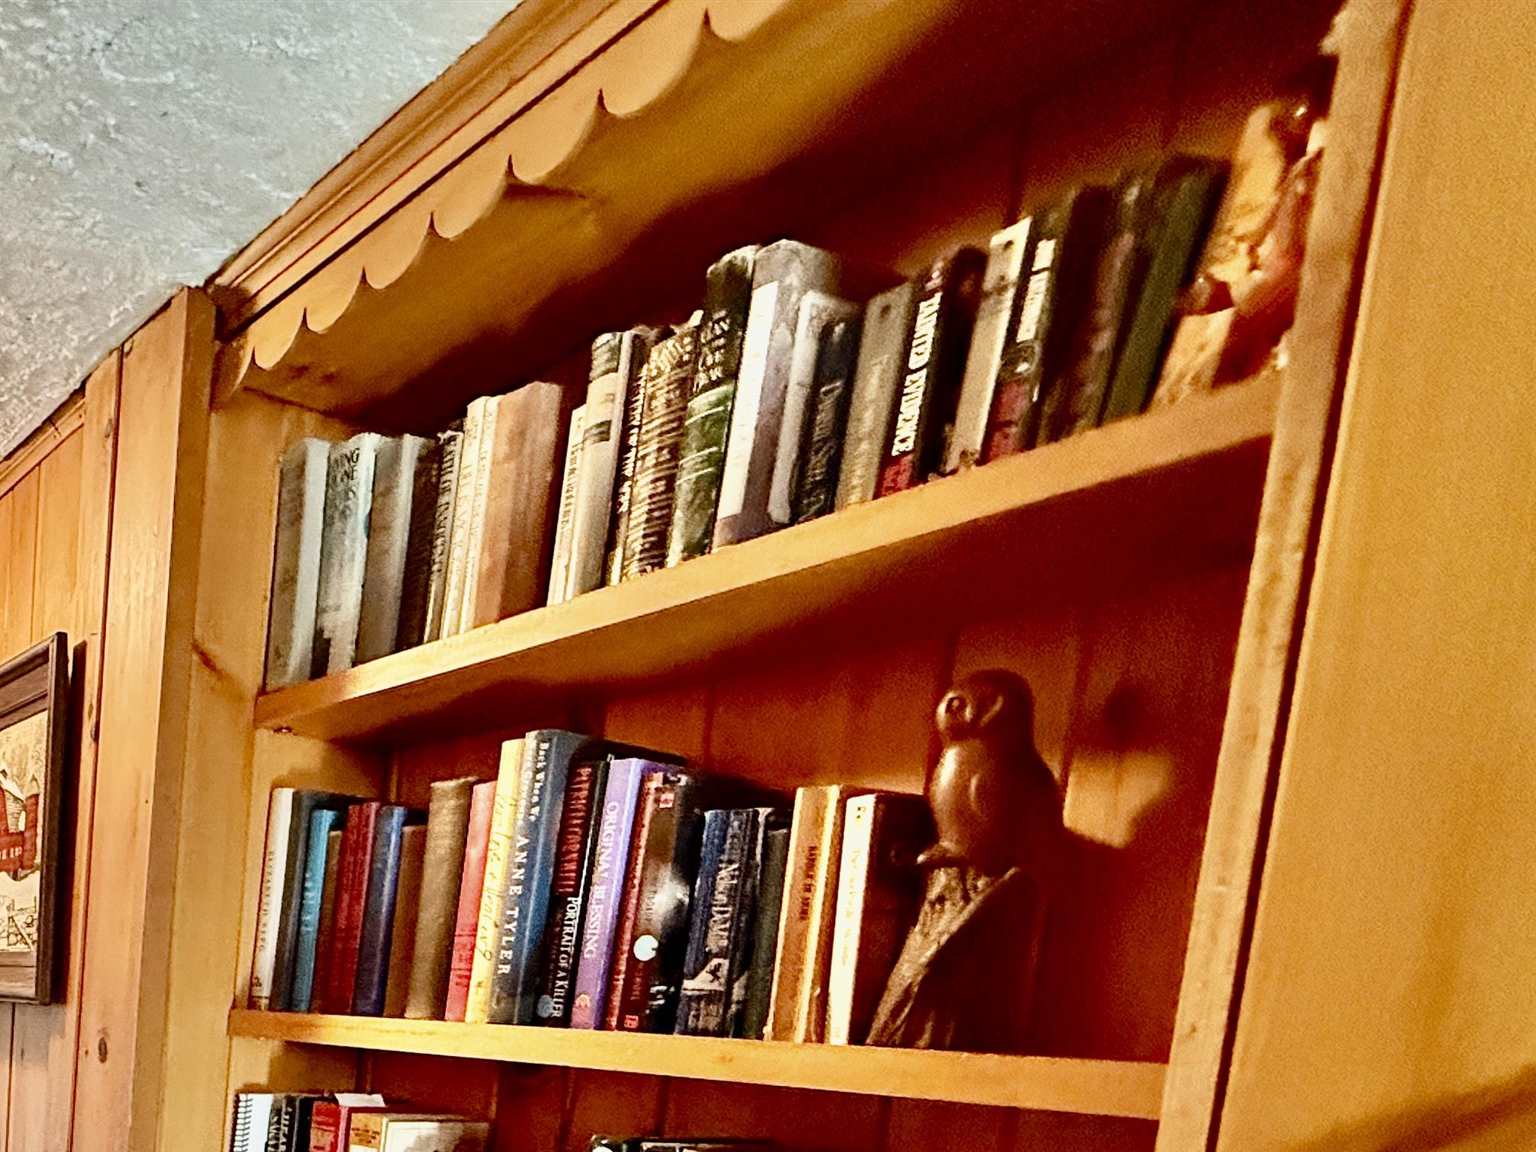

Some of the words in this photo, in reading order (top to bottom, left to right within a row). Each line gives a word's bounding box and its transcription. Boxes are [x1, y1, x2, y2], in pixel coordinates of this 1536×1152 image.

[905, 291, 941, 372] TAINTED
[889, 367, 927, 460] EVIDENCE
[507, 834, 530, 897] ANNE
[496, 906, 520, 975] TYLER
[558, 895, 580, 952] PORTRAIT
[582, 884, 607, 959] BLESSING
[556, 953, 569, 968] OF
[549, 979, 569, 1018] KILLER
